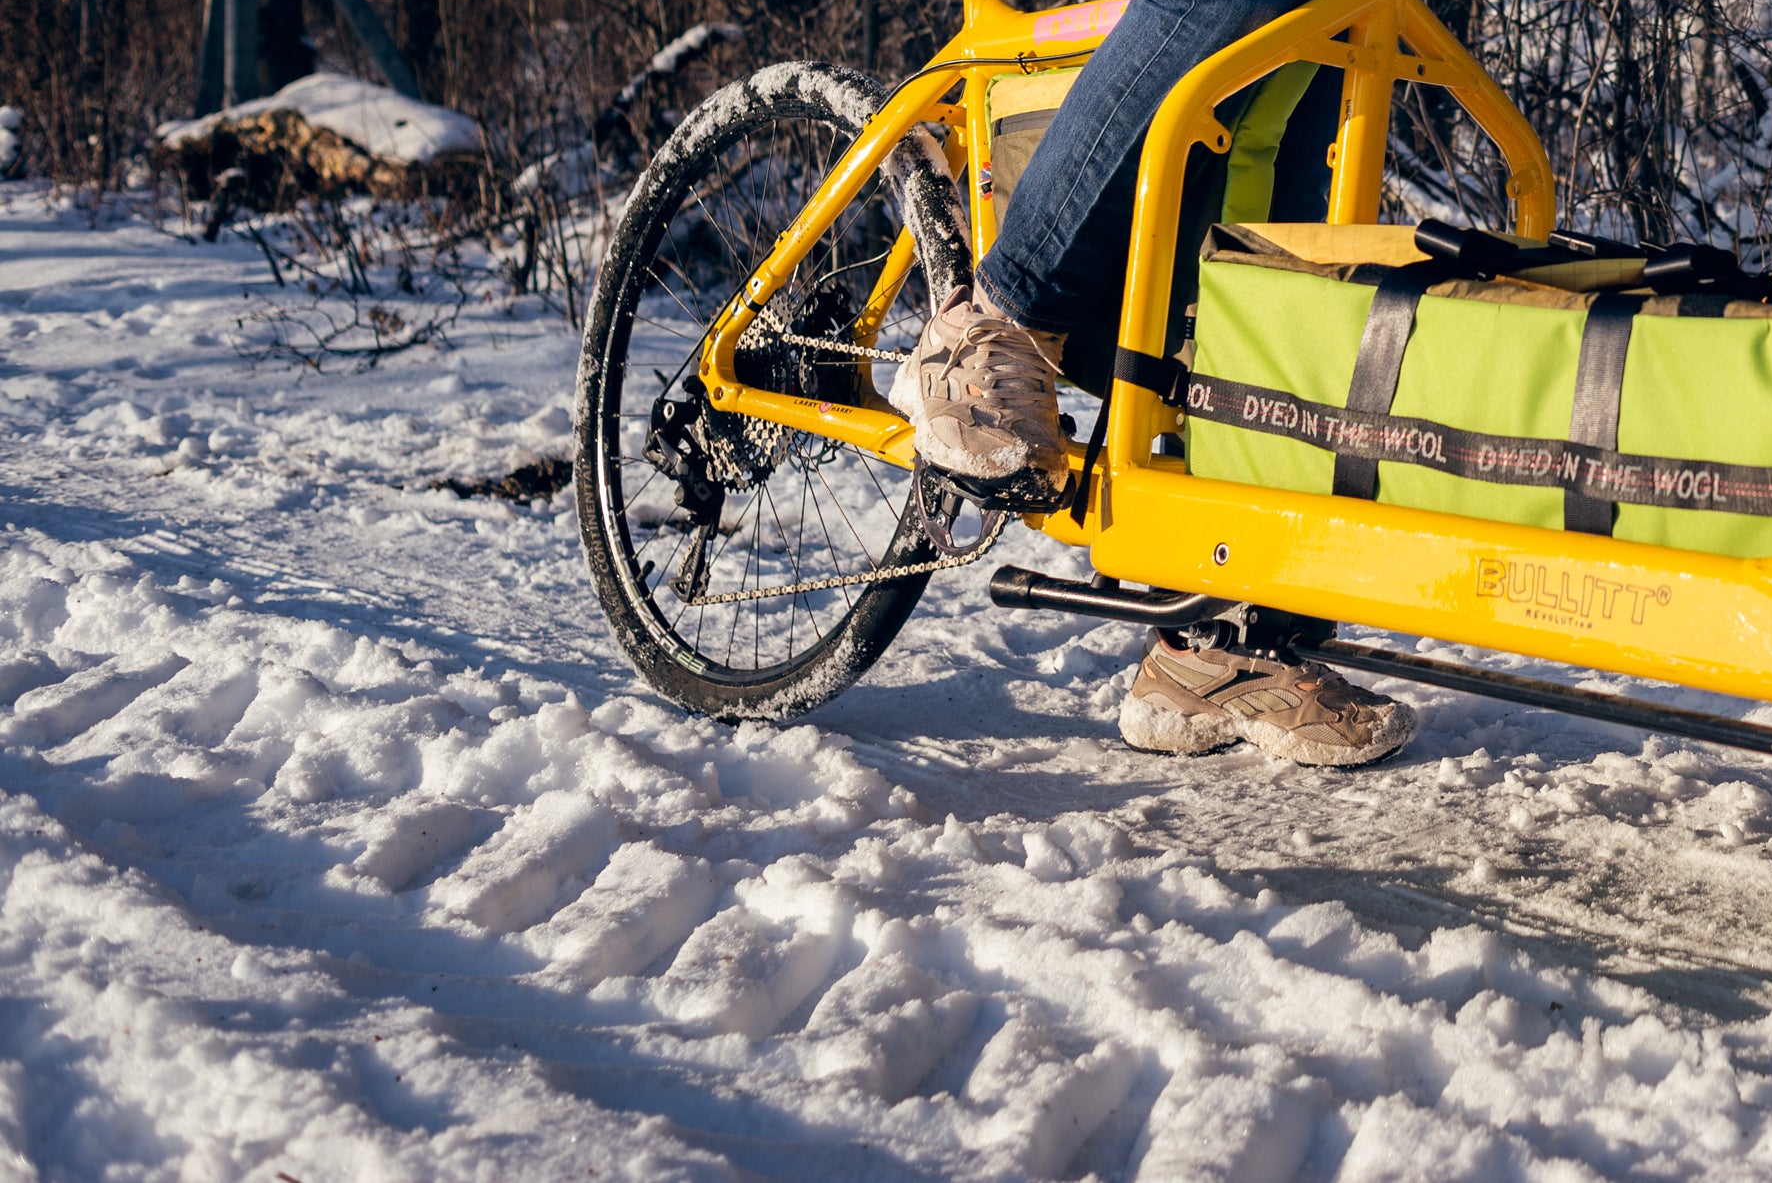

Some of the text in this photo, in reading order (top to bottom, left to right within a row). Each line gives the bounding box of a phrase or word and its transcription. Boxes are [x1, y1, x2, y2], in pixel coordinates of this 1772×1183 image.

[794, 399, 818, 408] LARRY
[1243, 395, 1299, 429] DYED
[1301, 410, 1319, 438] IN
[1325, 416, 1373, 449] THE
[1383, 426, 1446, 464] WOOL
[1477, 444, 1552, 477] DYED
[1586, 458, 1642, 493] THE
[581, 460, 610, 574] CONTINENTAL
[1526, 609, 1593, 629] REVOLUTION
